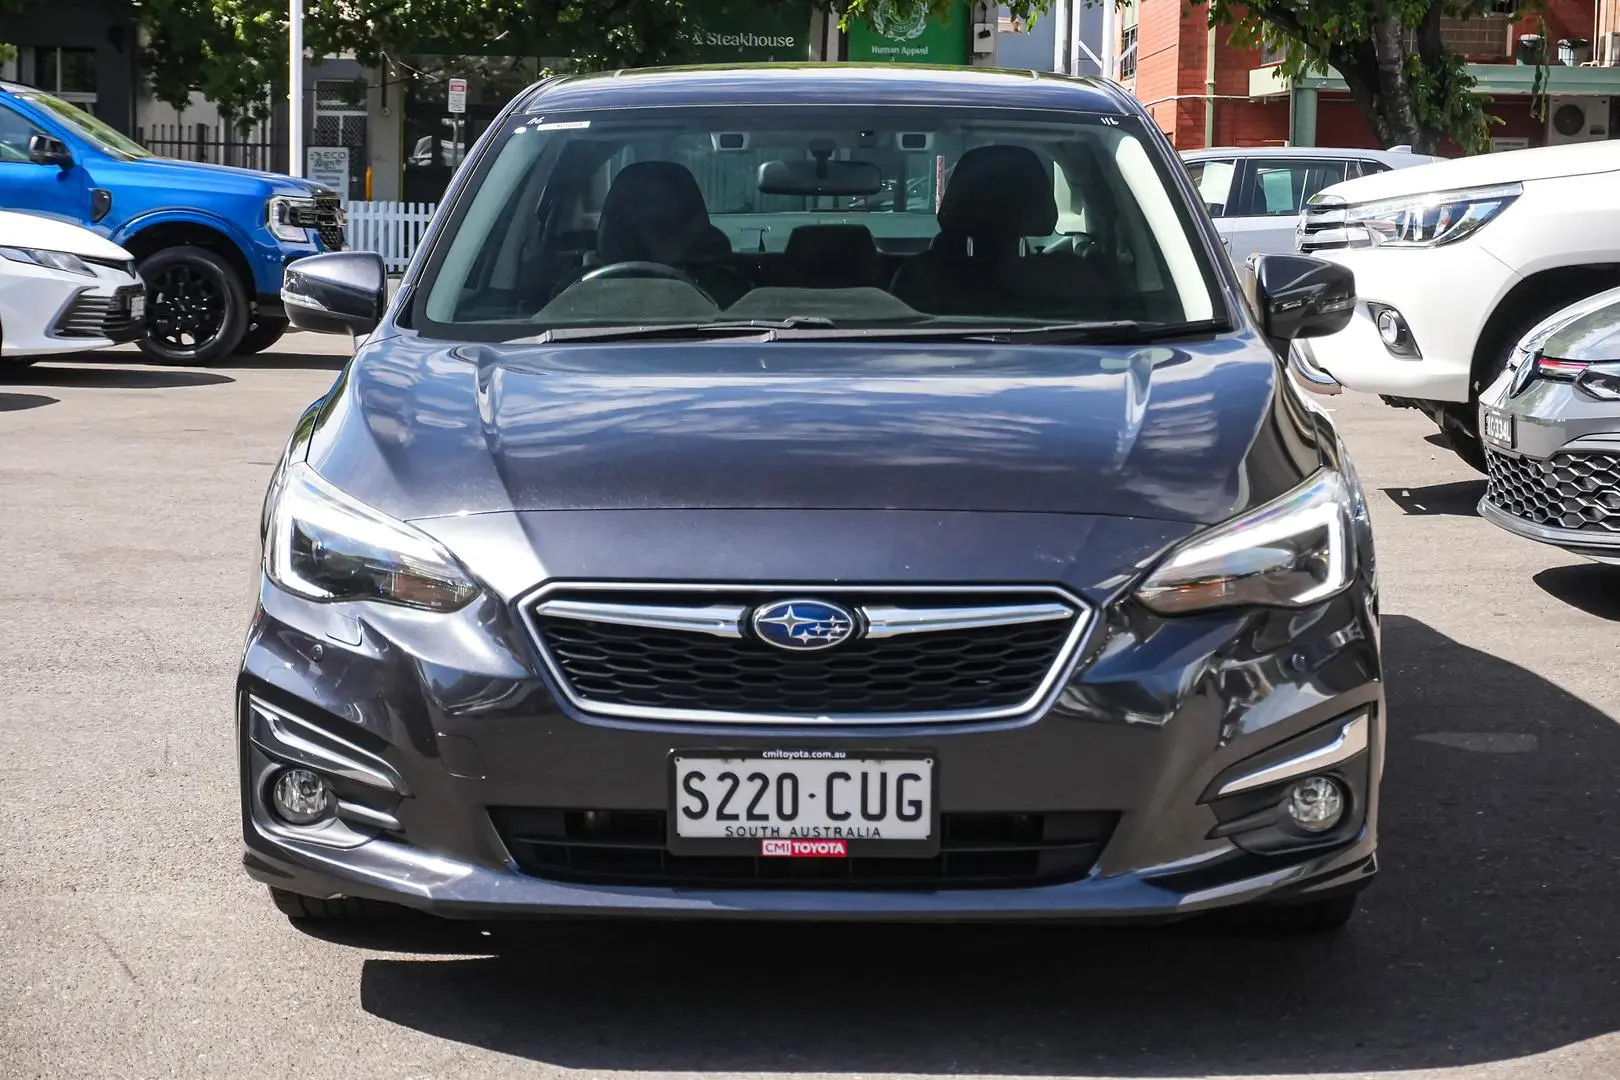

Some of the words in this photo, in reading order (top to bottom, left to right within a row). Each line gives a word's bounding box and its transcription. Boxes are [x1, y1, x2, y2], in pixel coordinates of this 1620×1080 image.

[706, 32, 794, 47] Steakhouse
[871, 45, 900, 54] Human
[901, 46, 929, 56] Appeal
[323, 151, 346, 160] ECO
[762, 750, 846, 760] cmitoyota.com.au
[725, 826, 780, 838] SOUTH
[789, 826, 881, 838] AUSTRALIA
[765, 842, 790, 853] CMI
[792, 842, 845, 854] TOYOTA
